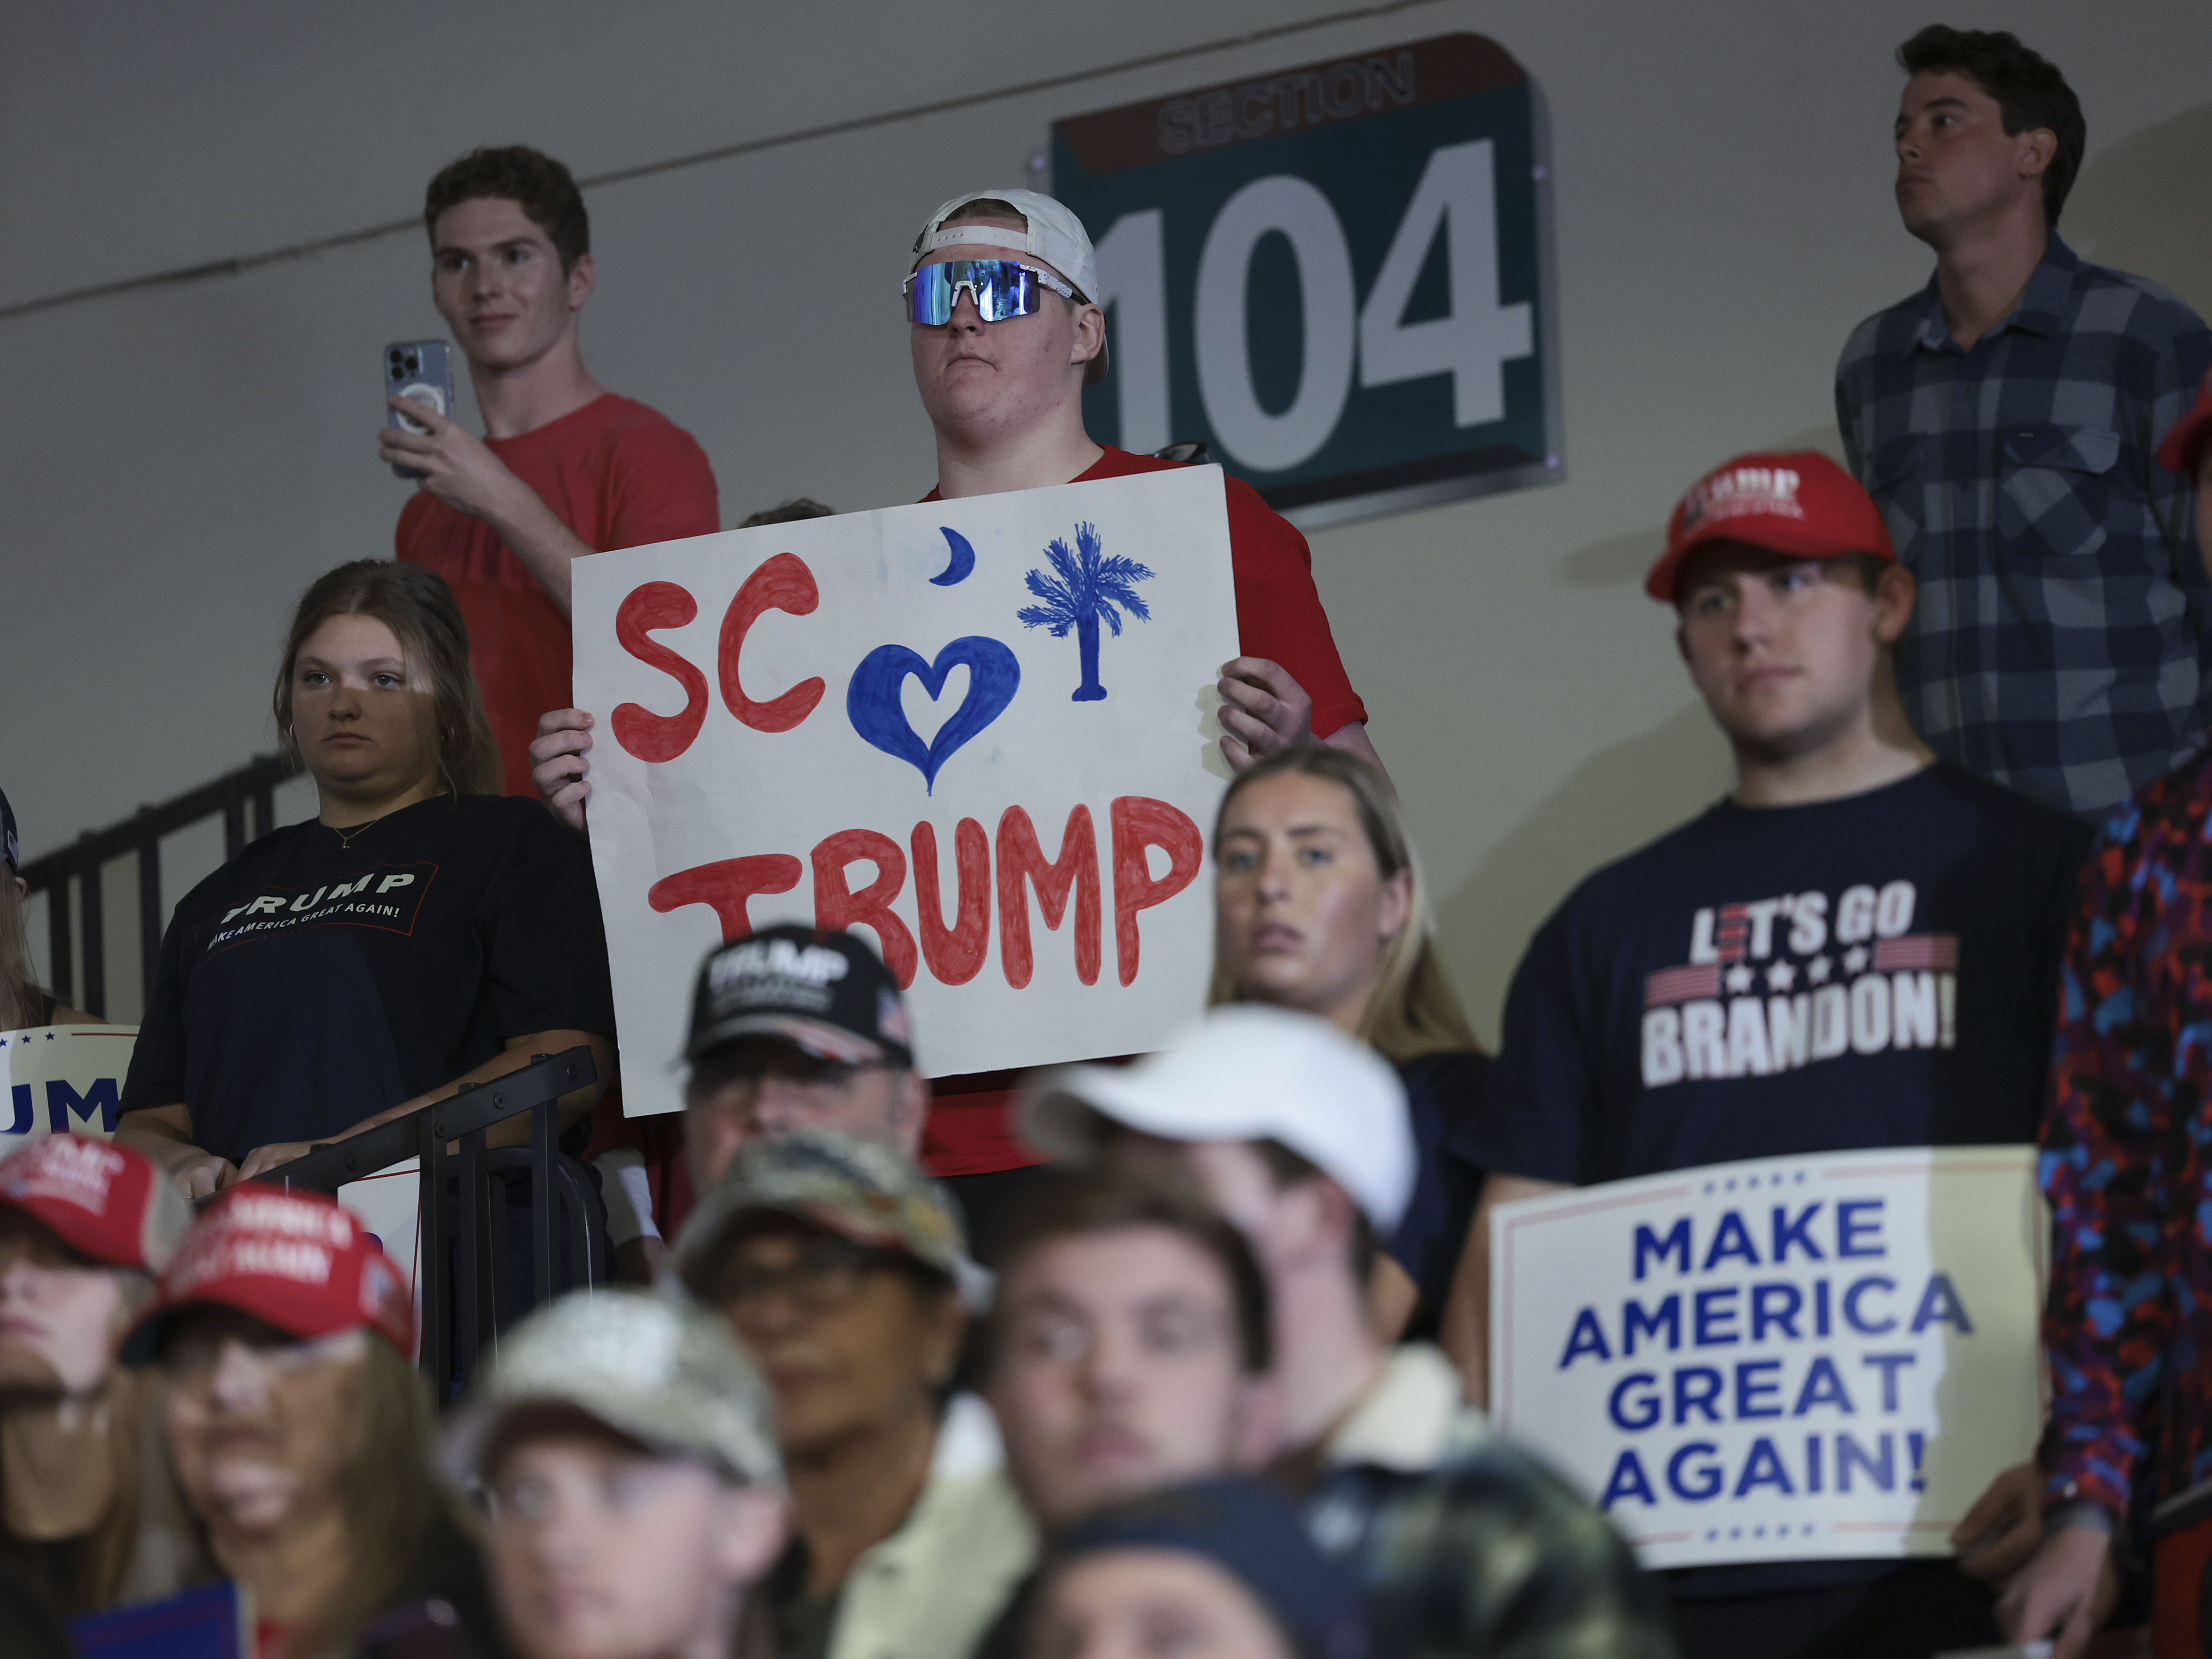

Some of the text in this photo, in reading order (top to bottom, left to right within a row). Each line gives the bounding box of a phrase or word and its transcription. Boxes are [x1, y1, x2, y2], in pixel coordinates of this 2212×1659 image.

[1158, 51, 1416, 154] SECTION
[1096, 137, 1533, 473] 104
[611, 552, 826, 763] SC
[221, 873, 414, 924] TRUMP
[234, 918, 296, 936] AMERICA
[301, 904, 343, 922] GREAT
[344, 903, 400, 918] AGAIN!
[648, 796, 1204, 990] TRUMP
[1689, 879, 1917, 965] LET'S GO
[1640, 972, 1957, 1089] BRANDON!
[1632, 1198, 1887, 1282] MAKE
[1557, 1272, 1975, 1371] AMERICA
[1608, 1352, 1916, 1432] GREAT
[1598, 1431, 1928, 1512] AGAIN!
